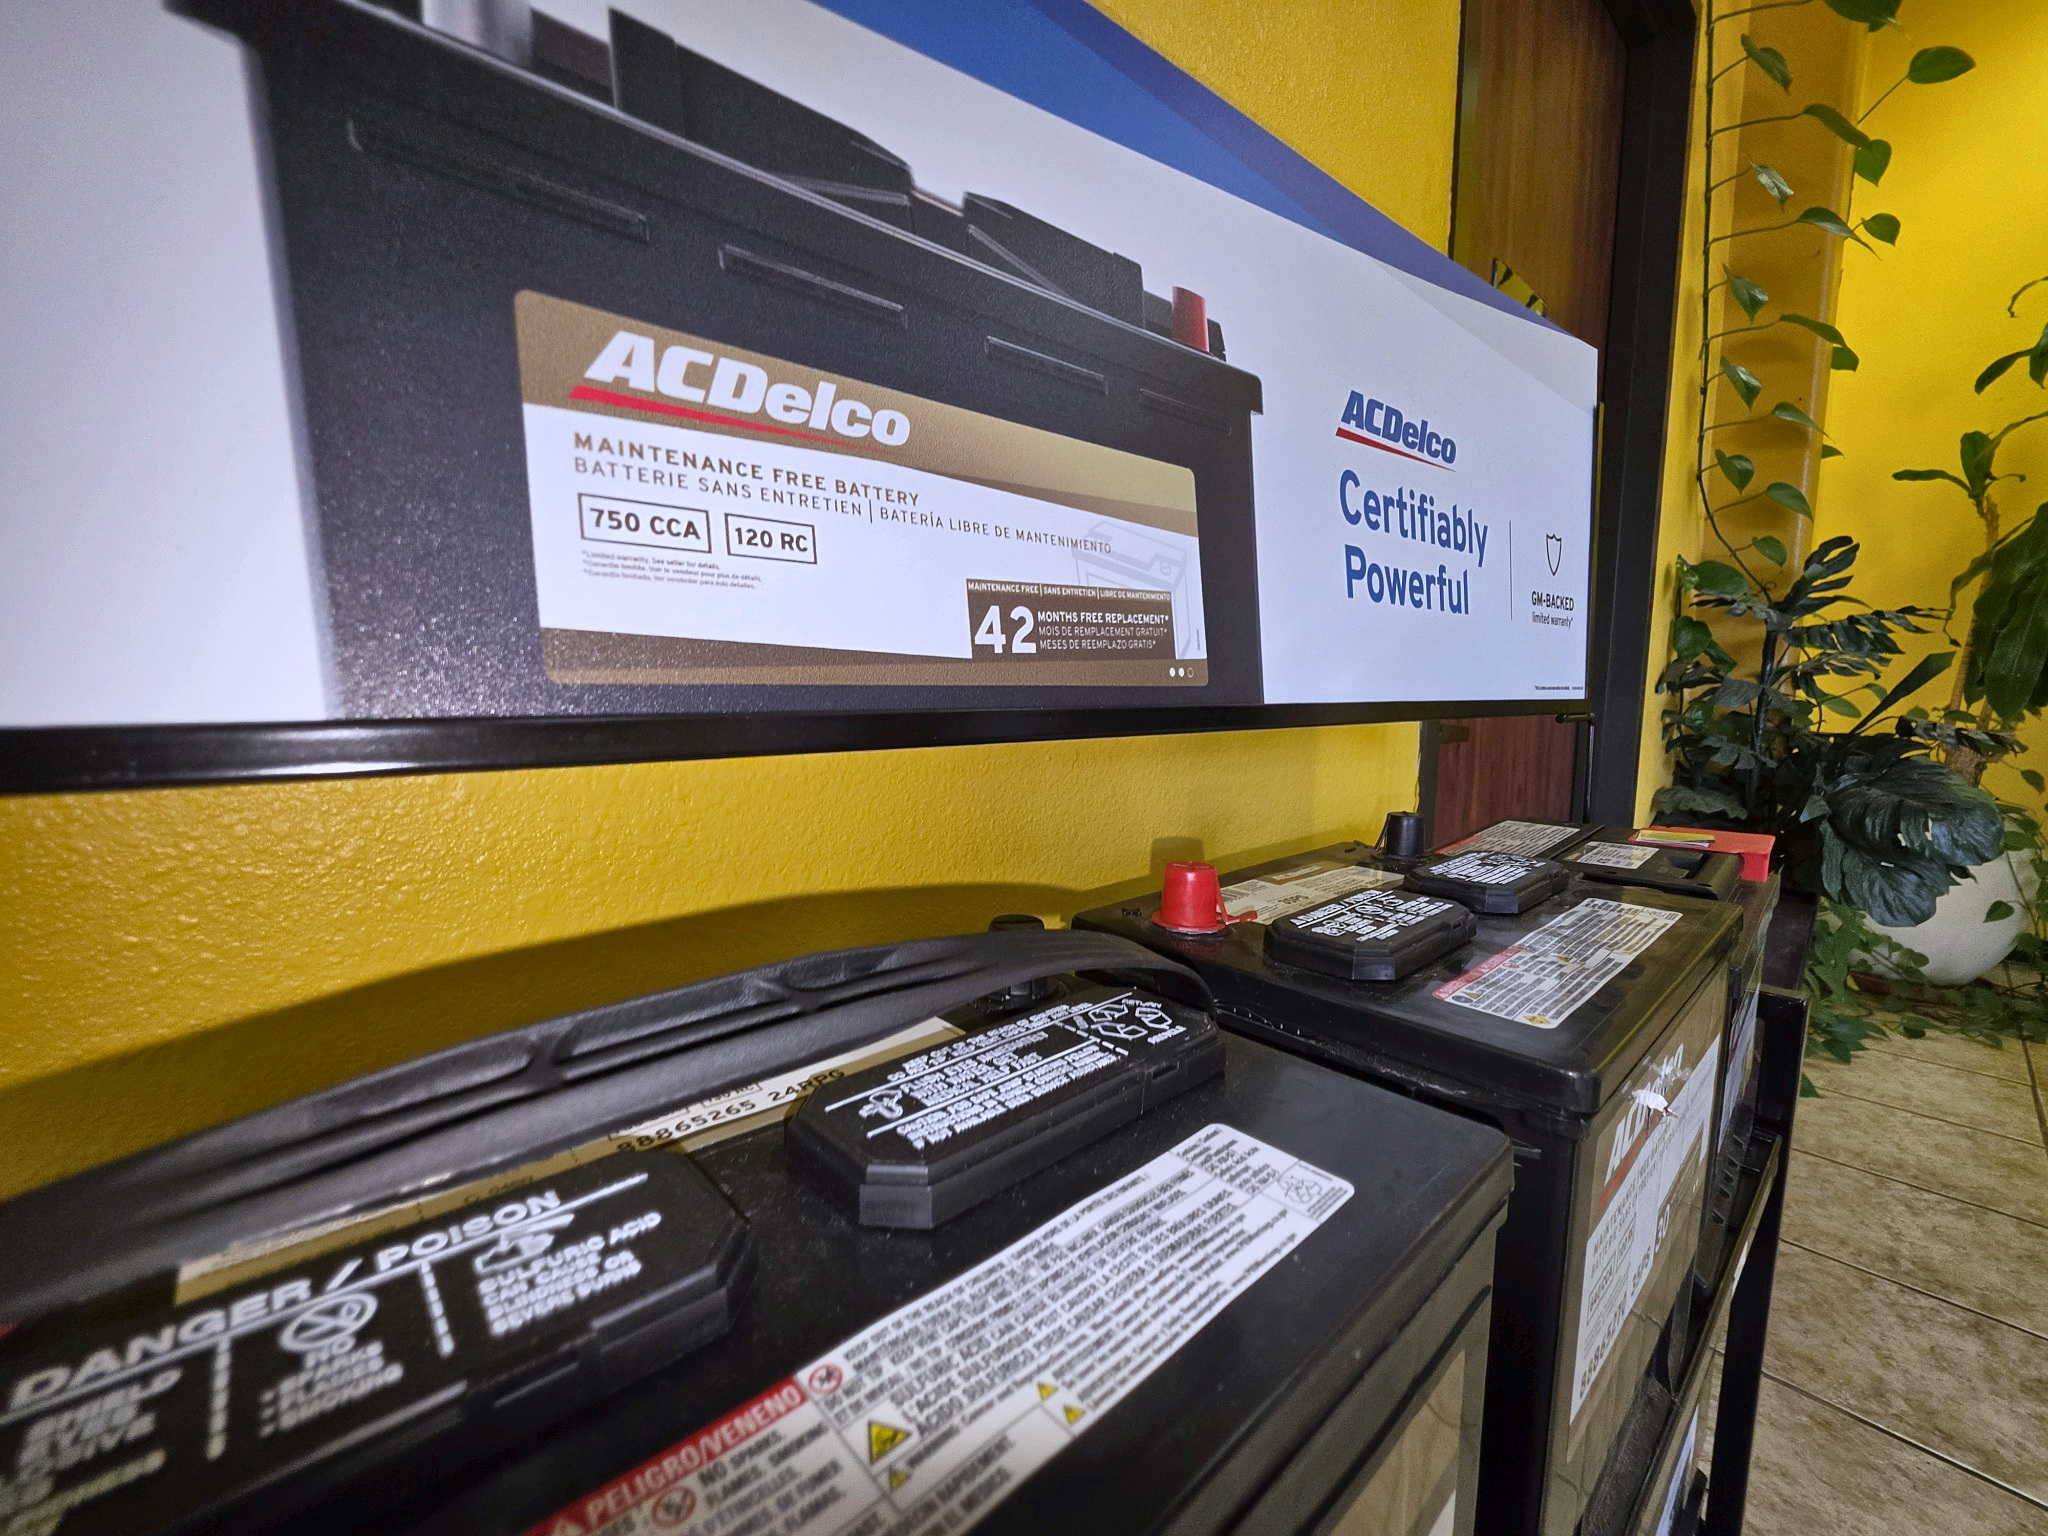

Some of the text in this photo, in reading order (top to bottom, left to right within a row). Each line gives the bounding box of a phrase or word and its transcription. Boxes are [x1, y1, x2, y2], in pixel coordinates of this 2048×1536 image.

[584, 330, 911, 446] ACDelco
[1340, 390, 1456, 464] ACDelco
[574, 432, 919, 507] MAINTENANCE FREE BATTERY
[575, 457, 862, 516] BATTERIE SANS ENTRETIEN
[590, 508, 700, 540] 750 CCA
[735, 527, 809, 552] 120 RC
[880, 506, 1112, 554] BATERÍA LIBRE DE MANTENIMIENTO
[1339, 469, 1488, 567] Certifiably
[967, 581, 1039, 594] MAINTENANCE FREE
[1043, 586, 1096, 598] SANS ENTRETIEN
[1100, 589, 1117, 598] LIBRE
[1118, 590, 1125, 599] DE
[1345, 544, 1469, 615] Powerful
[1531, 591, 1574, 611] GM-BACKED
[975, 604, 1037, 654] 42
[1037, 611, 1078, 623] MONTHS
[1080, 612, 1104, 624] FREE
[1038, 626, 1060, 636] MOIS
[1061, 626, 1072, 636] DE
[1074, 626, 1134, 637] REMPLACEMENT
[1532, 611, 1550, 625] limited
[1040, 639, 1067, 650] MESES
[1069, 639, 1080, 649] DE
[1082, 639, 1127, 650] REEMPLAZO
[617, 1099, 756, 1152] 88865265
[767, 1068, 846, 1102] 24RPG
[9, 1278, 313, 1411] DANGER
[376, 1190, 561, 1273] POISON
[584, 1384, 803, 1528] PELIGRO/VENENO
